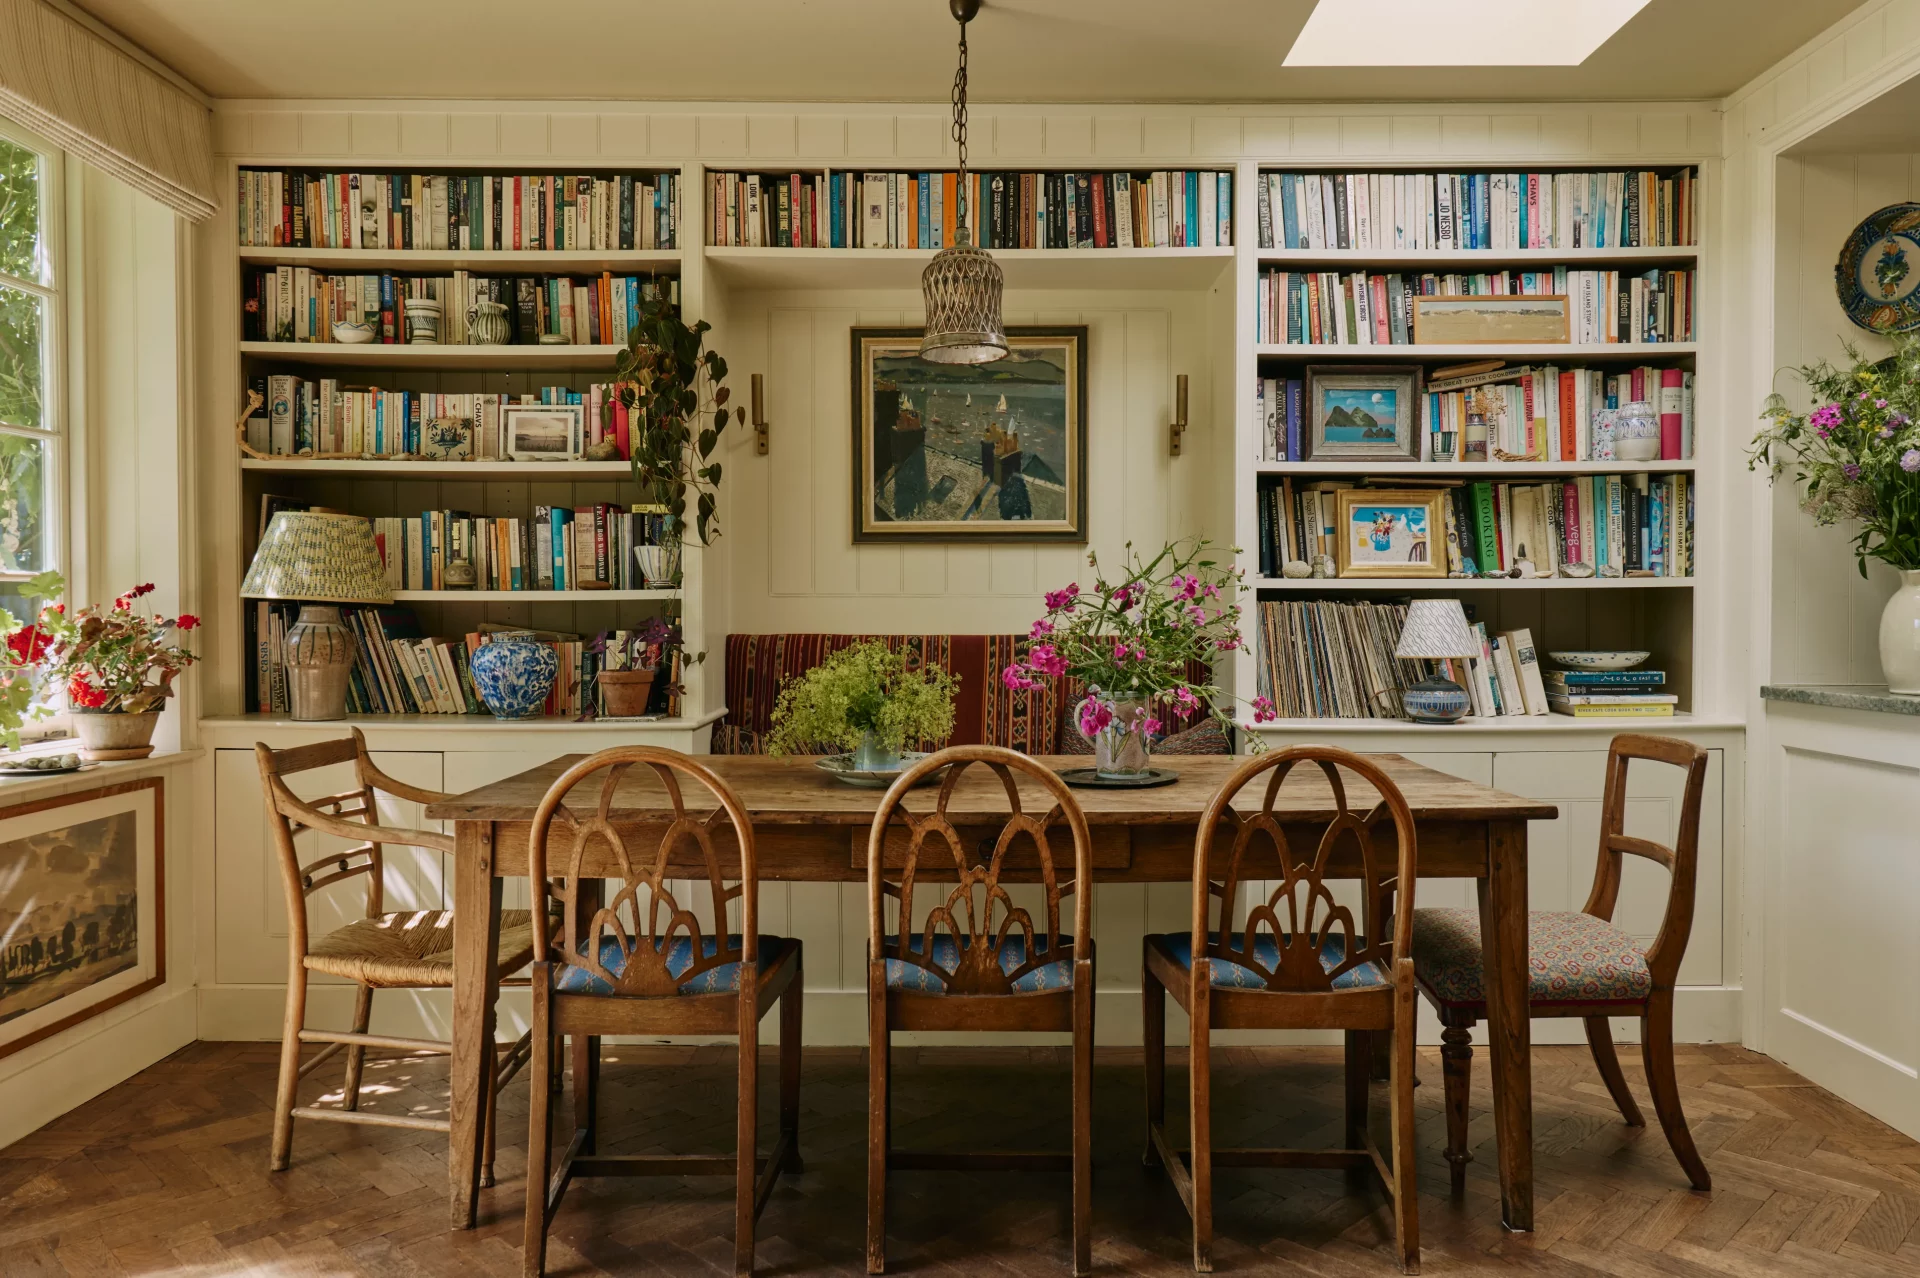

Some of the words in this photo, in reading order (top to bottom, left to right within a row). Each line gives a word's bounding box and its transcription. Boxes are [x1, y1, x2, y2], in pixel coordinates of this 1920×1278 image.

[749, 183, 758, 199] LOOK
[921, 175, 929, 188] The
[1258, 178, 1269, 202] ZADIE
[1529, 178, 1537, 206] CHAVS
[750, 203, 758, 213] ME
[920, 188, 929, 217] Peregrine
[1120, 203, 1125, 211] OF
[1260, 202, 1270, 227] SMITH
[1439, 203, 1450, 213] JO
[294, 206, 304, 239] ALAMEIN
[1440, 215, 1451, 240] NESBO
[1310, 281, 1318, 306] BRAZIL
[1619, 292, 1630, 317] gideon
[1359, 304, 1367, 322] CIRCUS
[1443, 379, 1462, 387] GREAT
[1464, 375, 1486, 384] DIXTER
[1488, 370, 1522, 380] COOKBOOK
[1524, 379, 1532, 393] FULL
[1525, 398, 1534, 422] FLAVOUR
[1305, 498, 1313, 516] Nigel
[1611, 481, 1622, 515] JERUSALEM
[1481, 498, 1495, 559] COOKING
[1567, 525, 1580, 546] veg
[260, 641, 269, 673] casas
